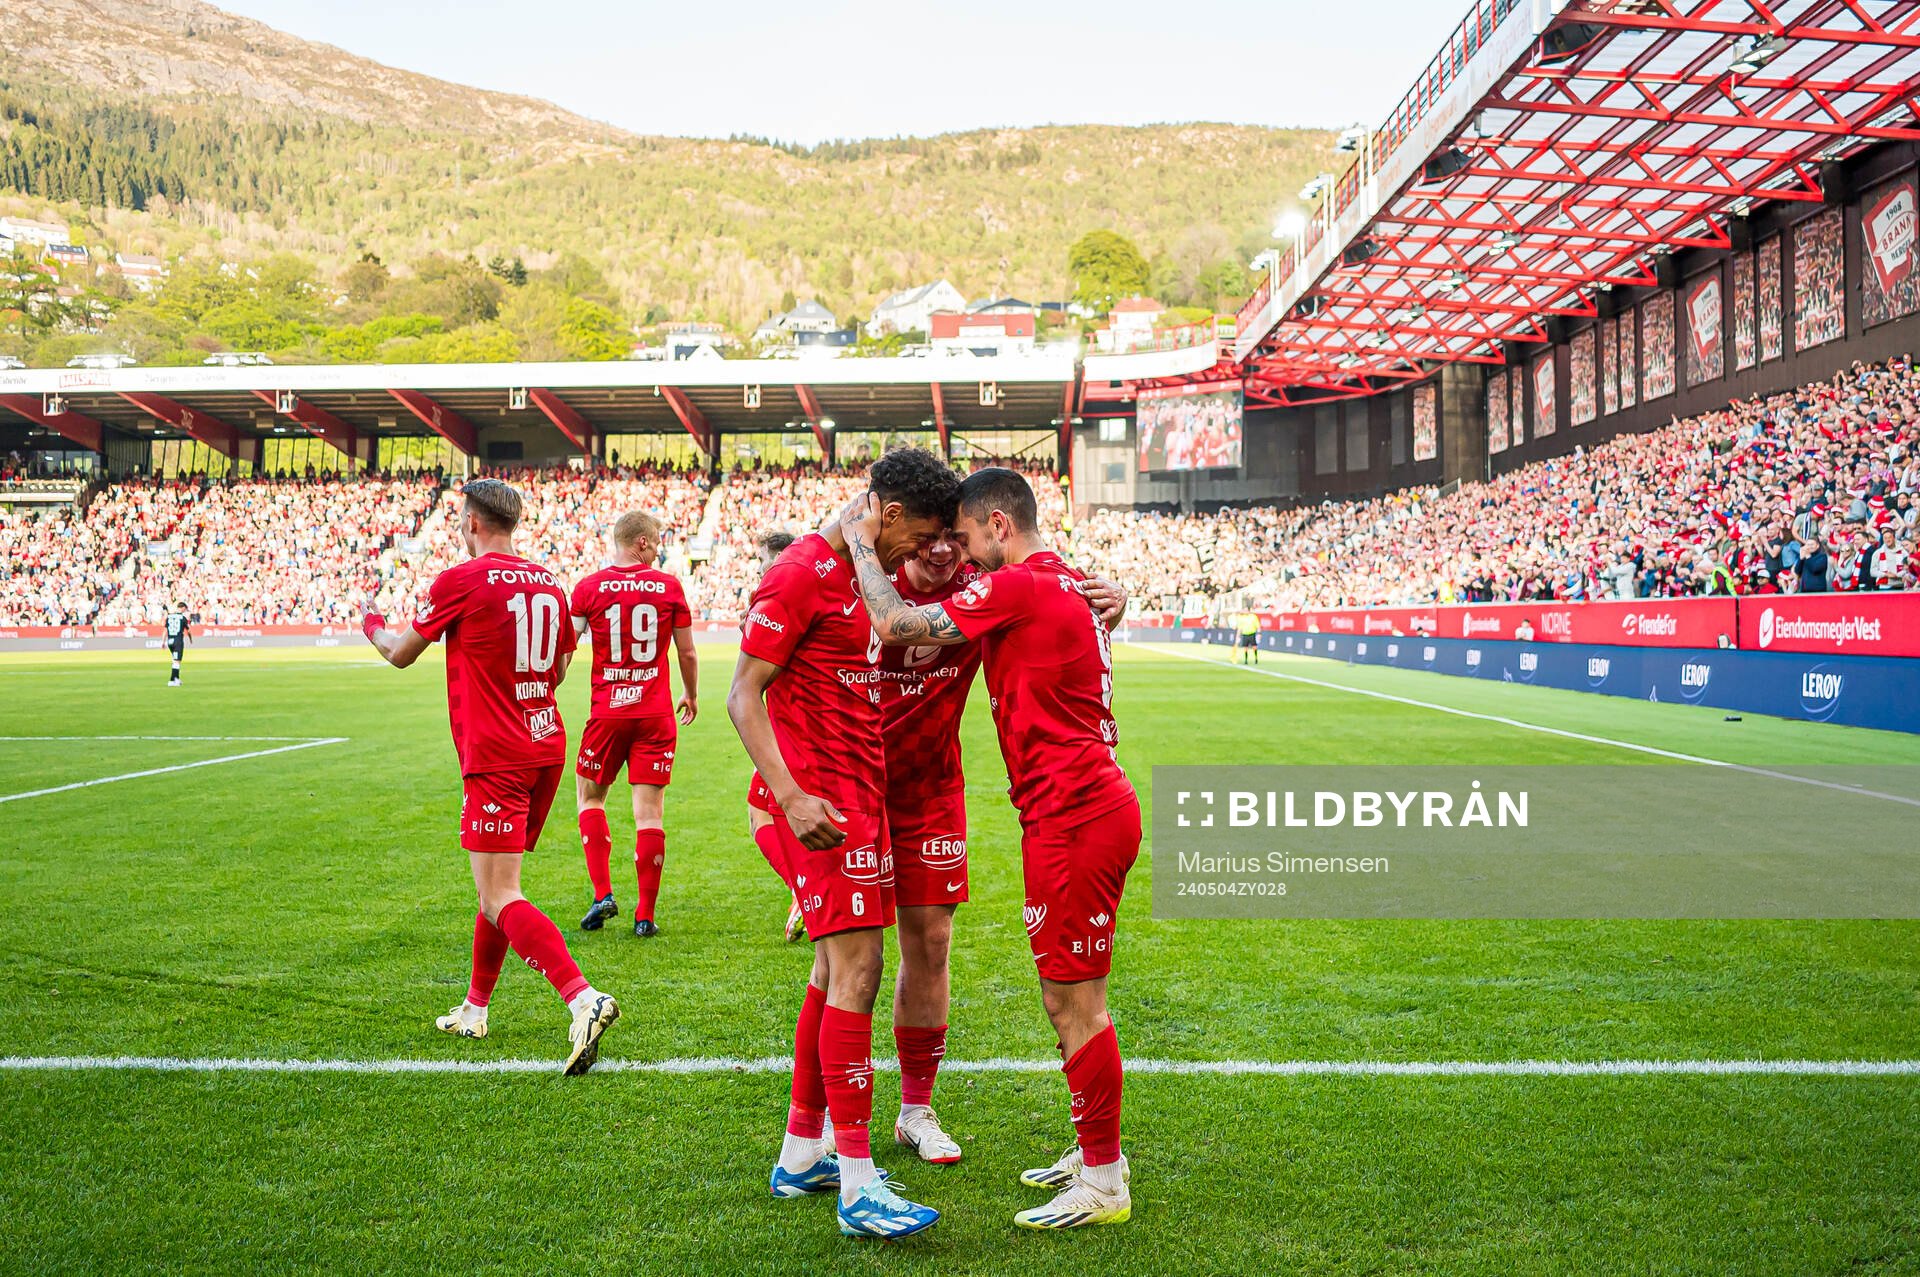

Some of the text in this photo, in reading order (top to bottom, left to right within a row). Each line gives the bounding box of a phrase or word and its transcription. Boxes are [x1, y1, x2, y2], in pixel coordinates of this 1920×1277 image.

[599, 580, 666, 593] FOTMOB
[506, 592, 560, 673] 10
[605, 603, 658, 663] 19
[750, 611, 785, 633] altibox
[1587, 658, 1610, 678] LERØY
[1681, 663, 1711, 687] LERØY
[1802, 672, 1842, 700] LERØY
[851, 892, 865, 916] 6
